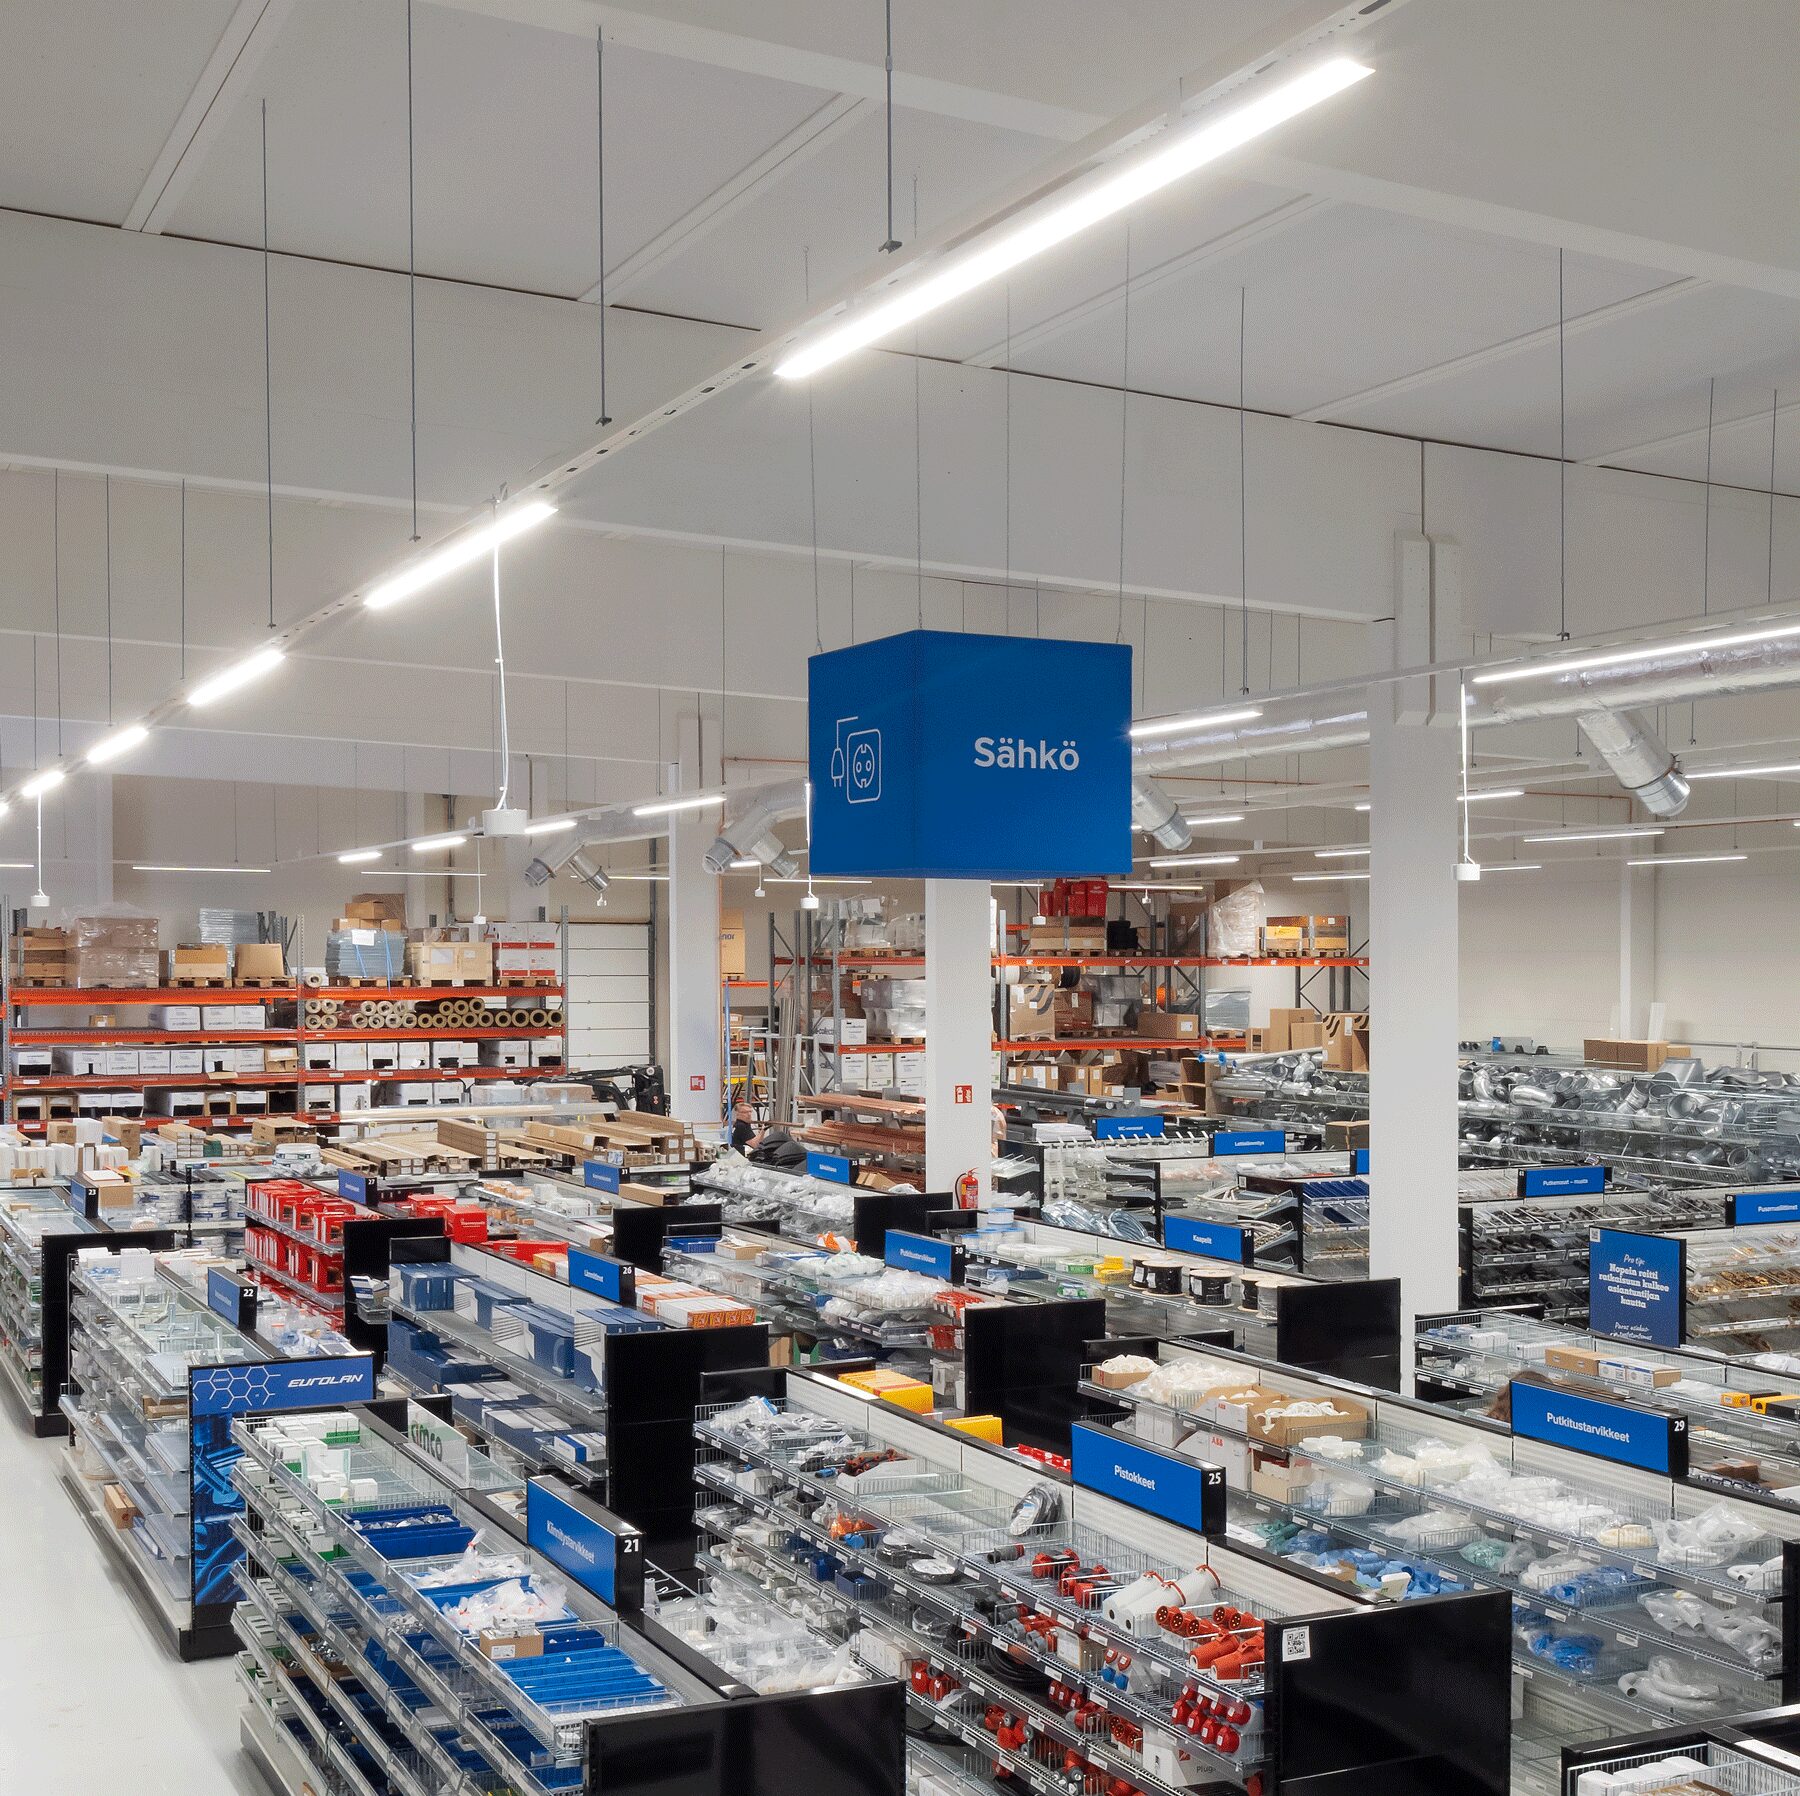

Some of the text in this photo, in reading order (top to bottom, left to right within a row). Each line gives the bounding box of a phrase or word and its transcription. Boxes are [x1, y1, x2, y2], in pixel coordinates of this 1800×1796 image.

[974, 736, 1080, 771] Sähkö
[954, 1246, 964, 1255] 30
[622, 1266, 632, 1275] 26
[1609, 1263, 1659, 1280] Nopein reitti
[1599, 1273, 1670, 1292] ratkaisuun kulkee
[243, 1288, 254, 1297] 22
[1607, 1285, 1660, 1301] asiantuntijan
[1620, 1296, 1647, 1308] kautta
[288, 1374, 364, 1388] EUROLAN
[1546, 1412, 1630, 1443] Putkitustarvikkeet
[1674, 1420, 1685, 1432] 29
[1114, 1464, 1156, 1491] Pistokkeet
[1208, 1472, 1221, 1485] 25
[623, 1538, 639, 1553] 21
